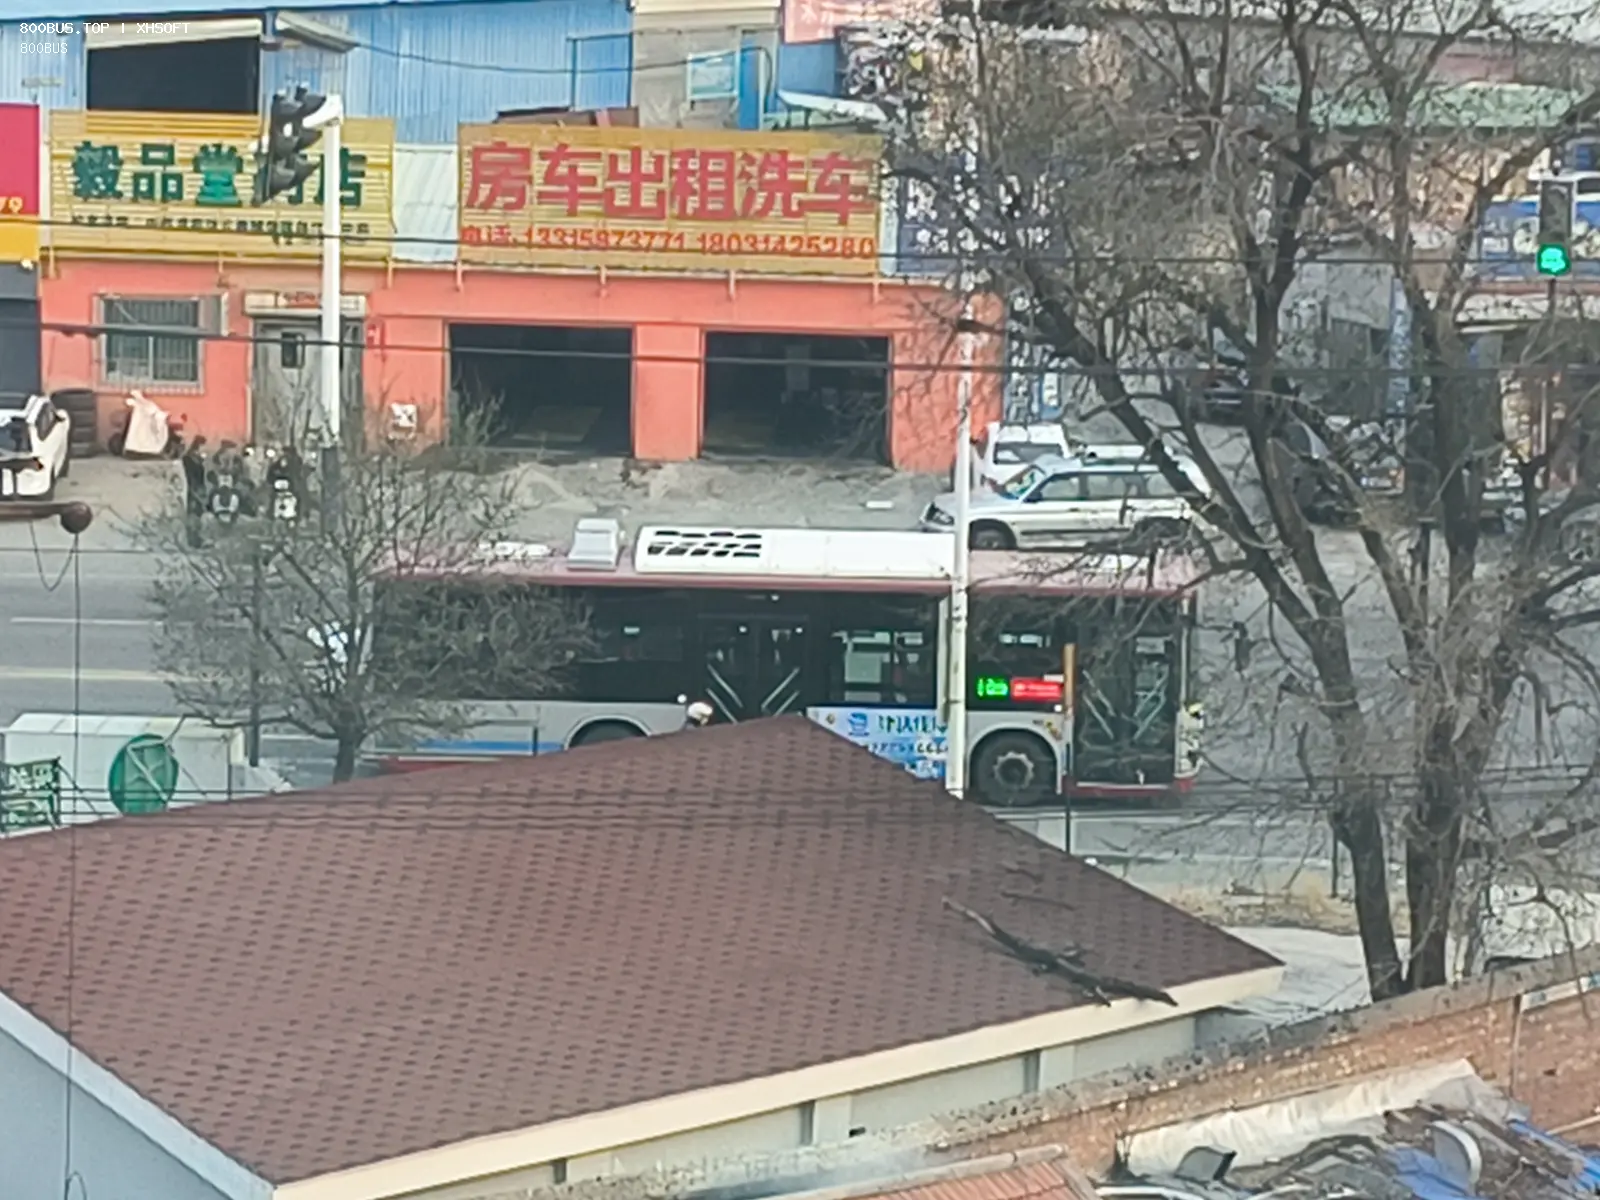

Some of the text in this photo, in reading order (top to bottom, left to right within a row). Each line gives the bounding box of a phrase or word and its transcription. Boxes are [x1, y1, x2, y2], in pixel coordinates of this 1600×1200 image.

[465, 141, 876, 226] 房车出租洗车
